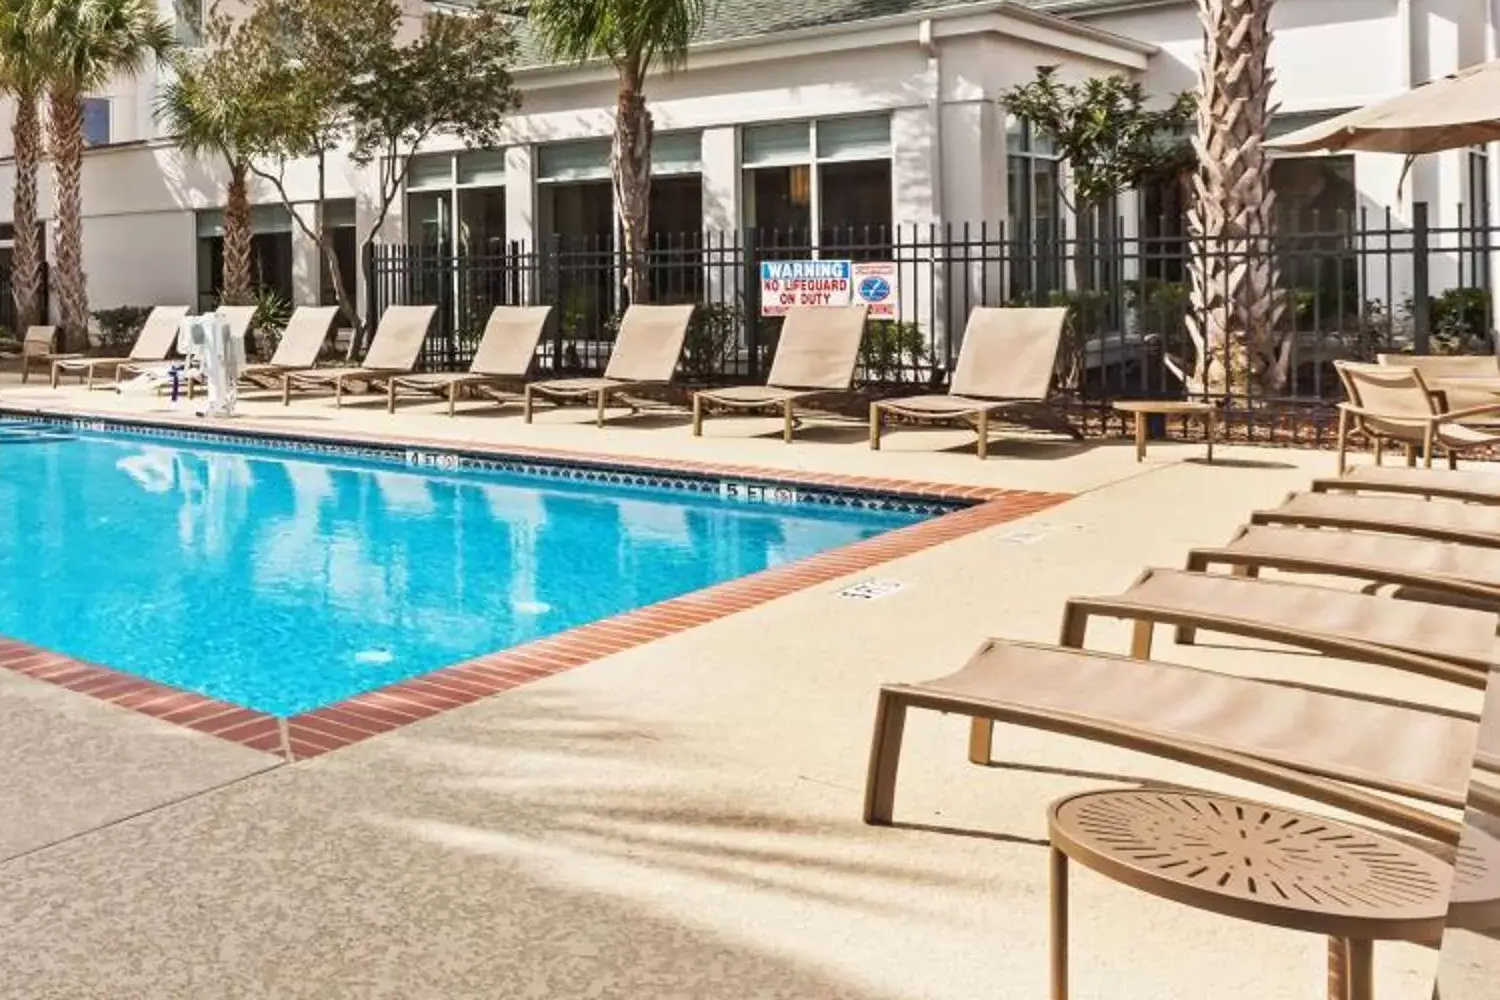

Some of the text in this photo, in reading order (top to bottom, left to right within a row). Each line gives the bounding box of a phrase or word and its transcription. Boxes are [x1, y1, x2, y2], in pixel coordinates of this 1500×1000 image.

[768, 262, 843, 279] WARNING
[764, 279, 847, 291] NO LIFEGUARD
[780, 293, 831, 305] ON DUTY
